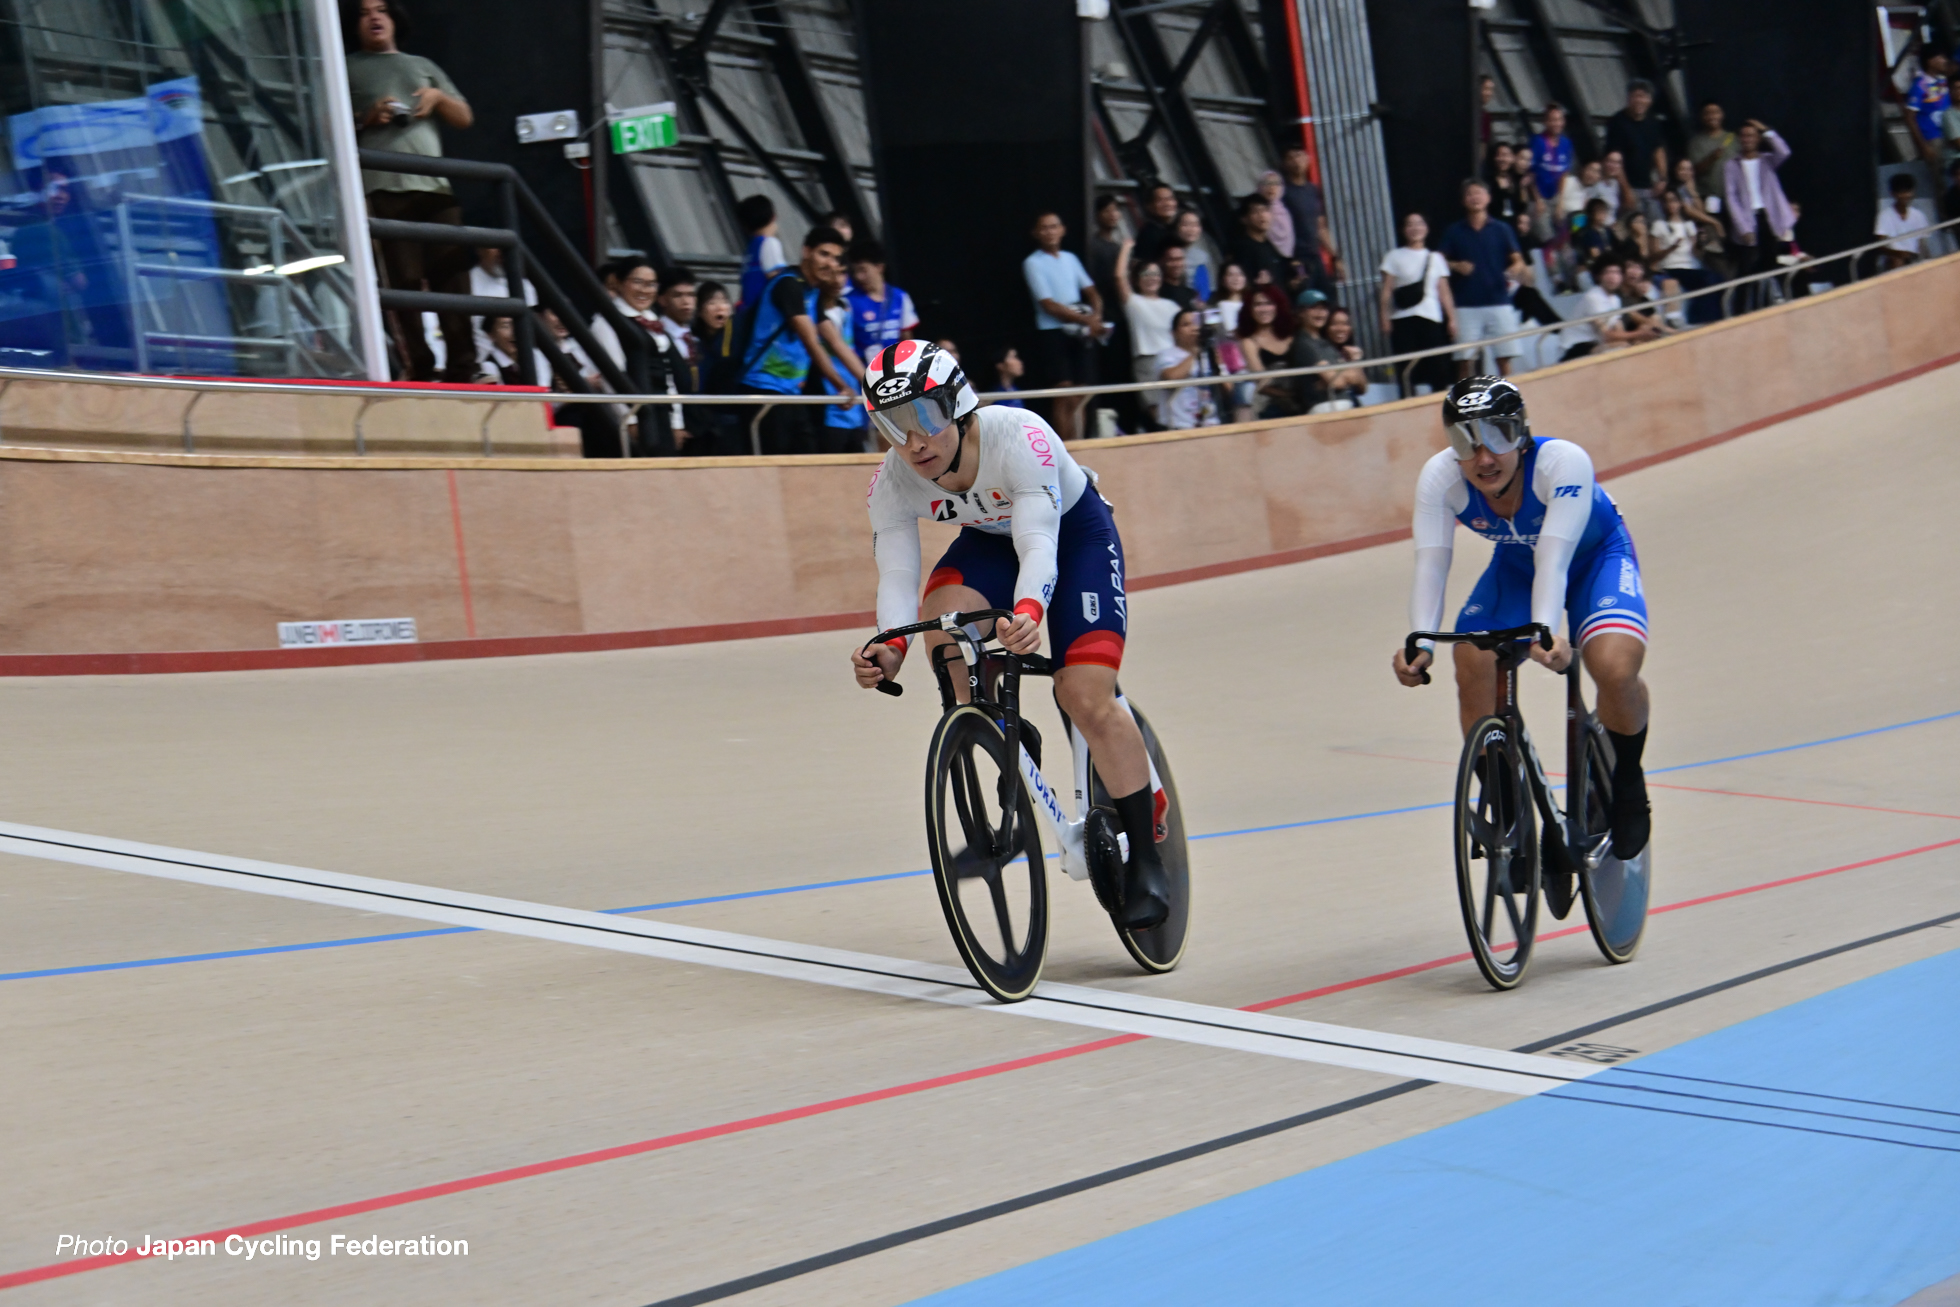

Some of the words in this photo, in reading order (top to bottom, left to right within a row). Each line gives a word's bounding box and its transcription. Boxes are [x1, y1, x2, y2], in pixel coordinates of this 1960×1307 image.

[620, 115, 665, 152] EXIT
[878, 390, 913, 405] Kabuto
[1554, 485, 1583, 498] TPE
